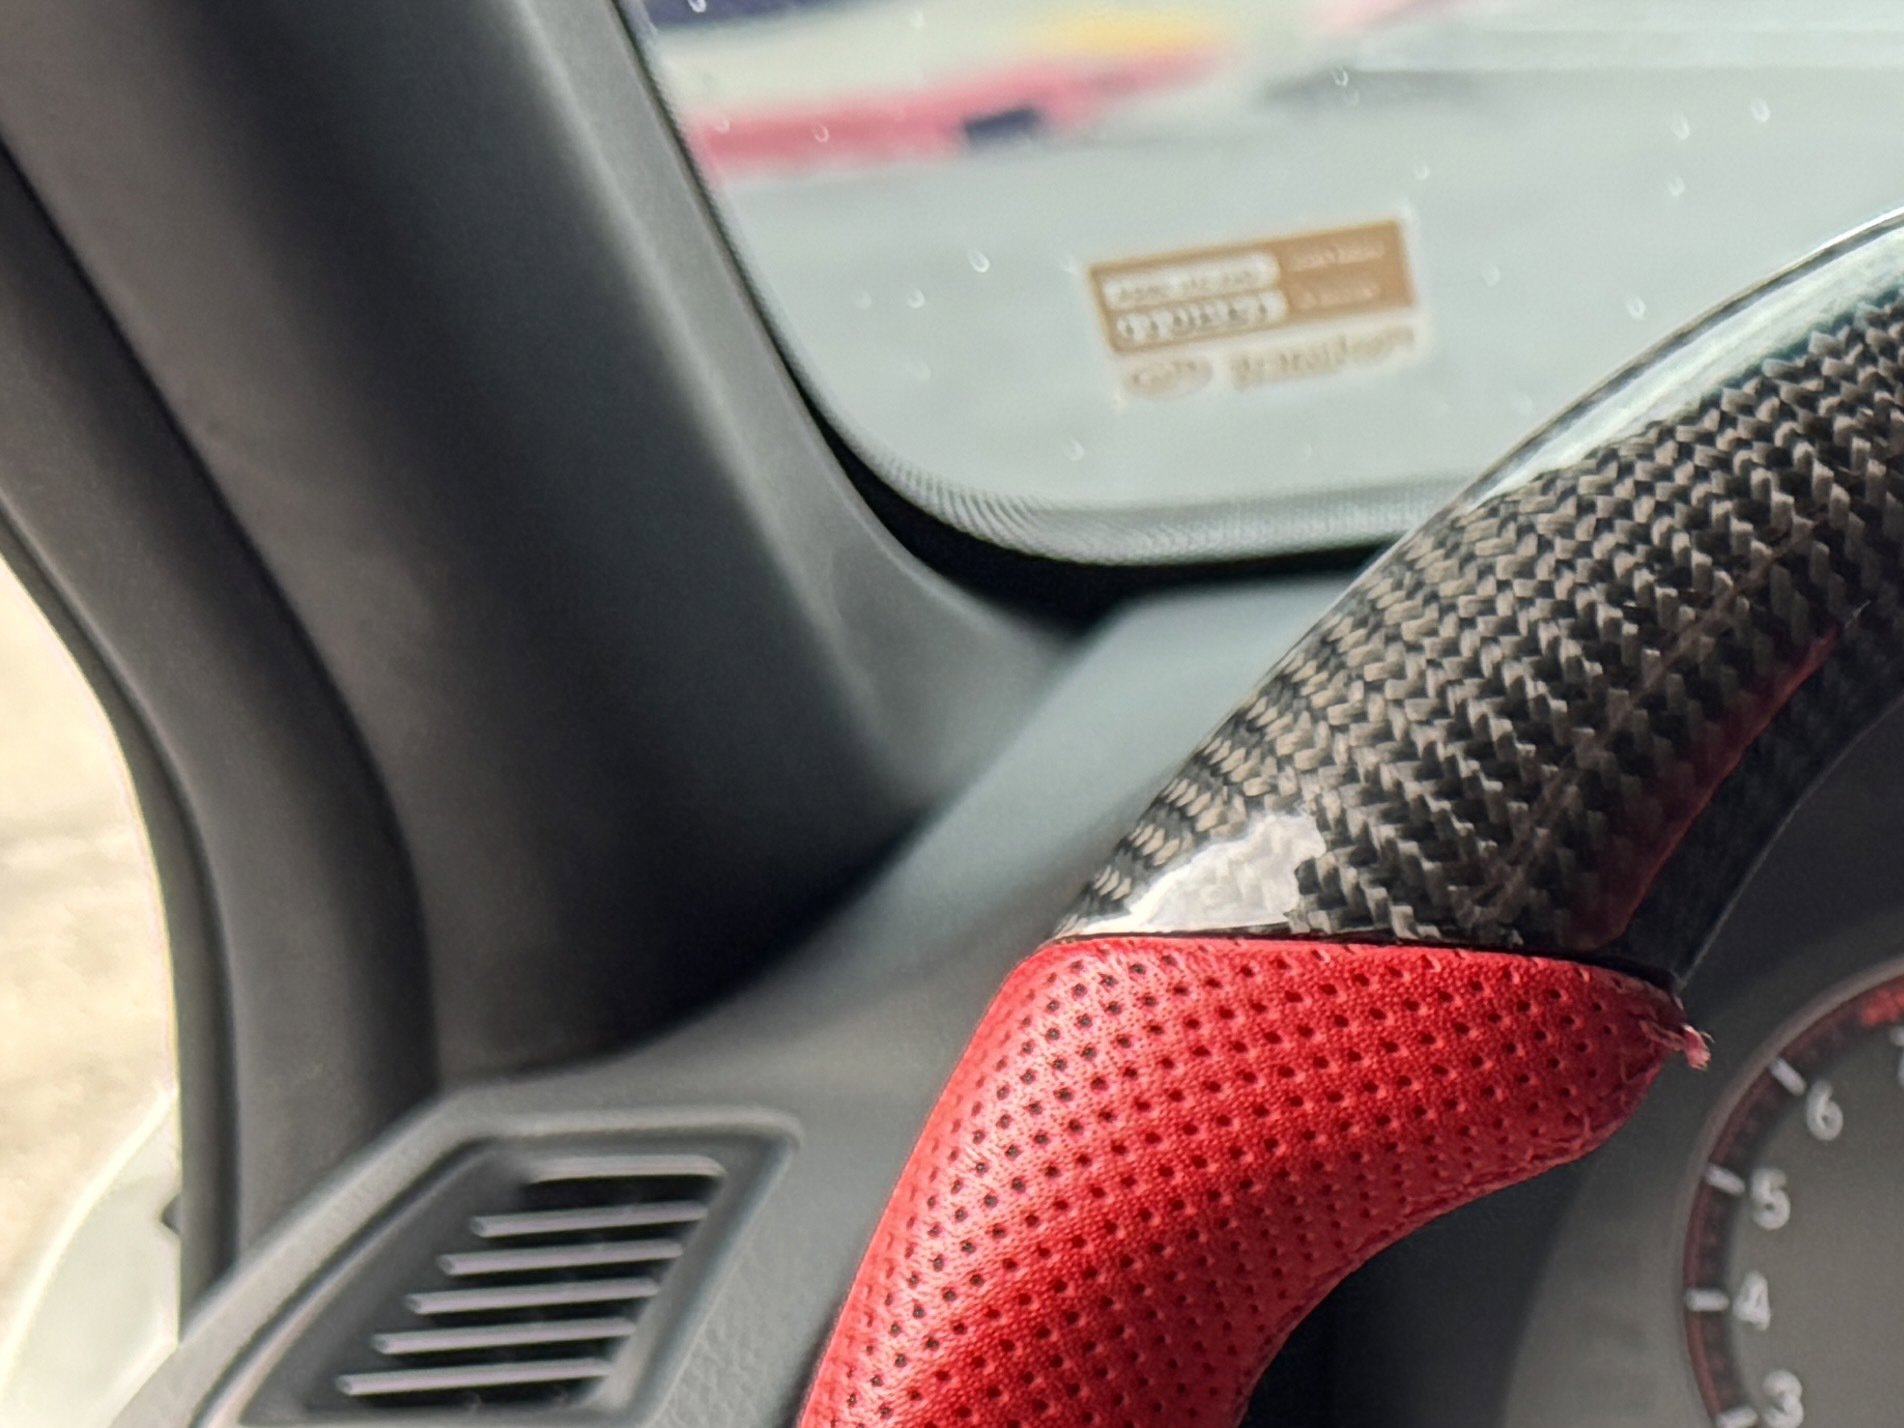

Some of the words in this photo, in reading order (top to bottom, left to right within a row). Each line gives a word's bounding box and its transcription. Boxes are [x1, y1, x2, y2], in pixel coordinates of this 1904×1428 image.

[1806, 1083, 1844, 1141] 6
[1752, 1168, 1791, 1230] 5
[1734, 1272, 1771, 1331] 4
